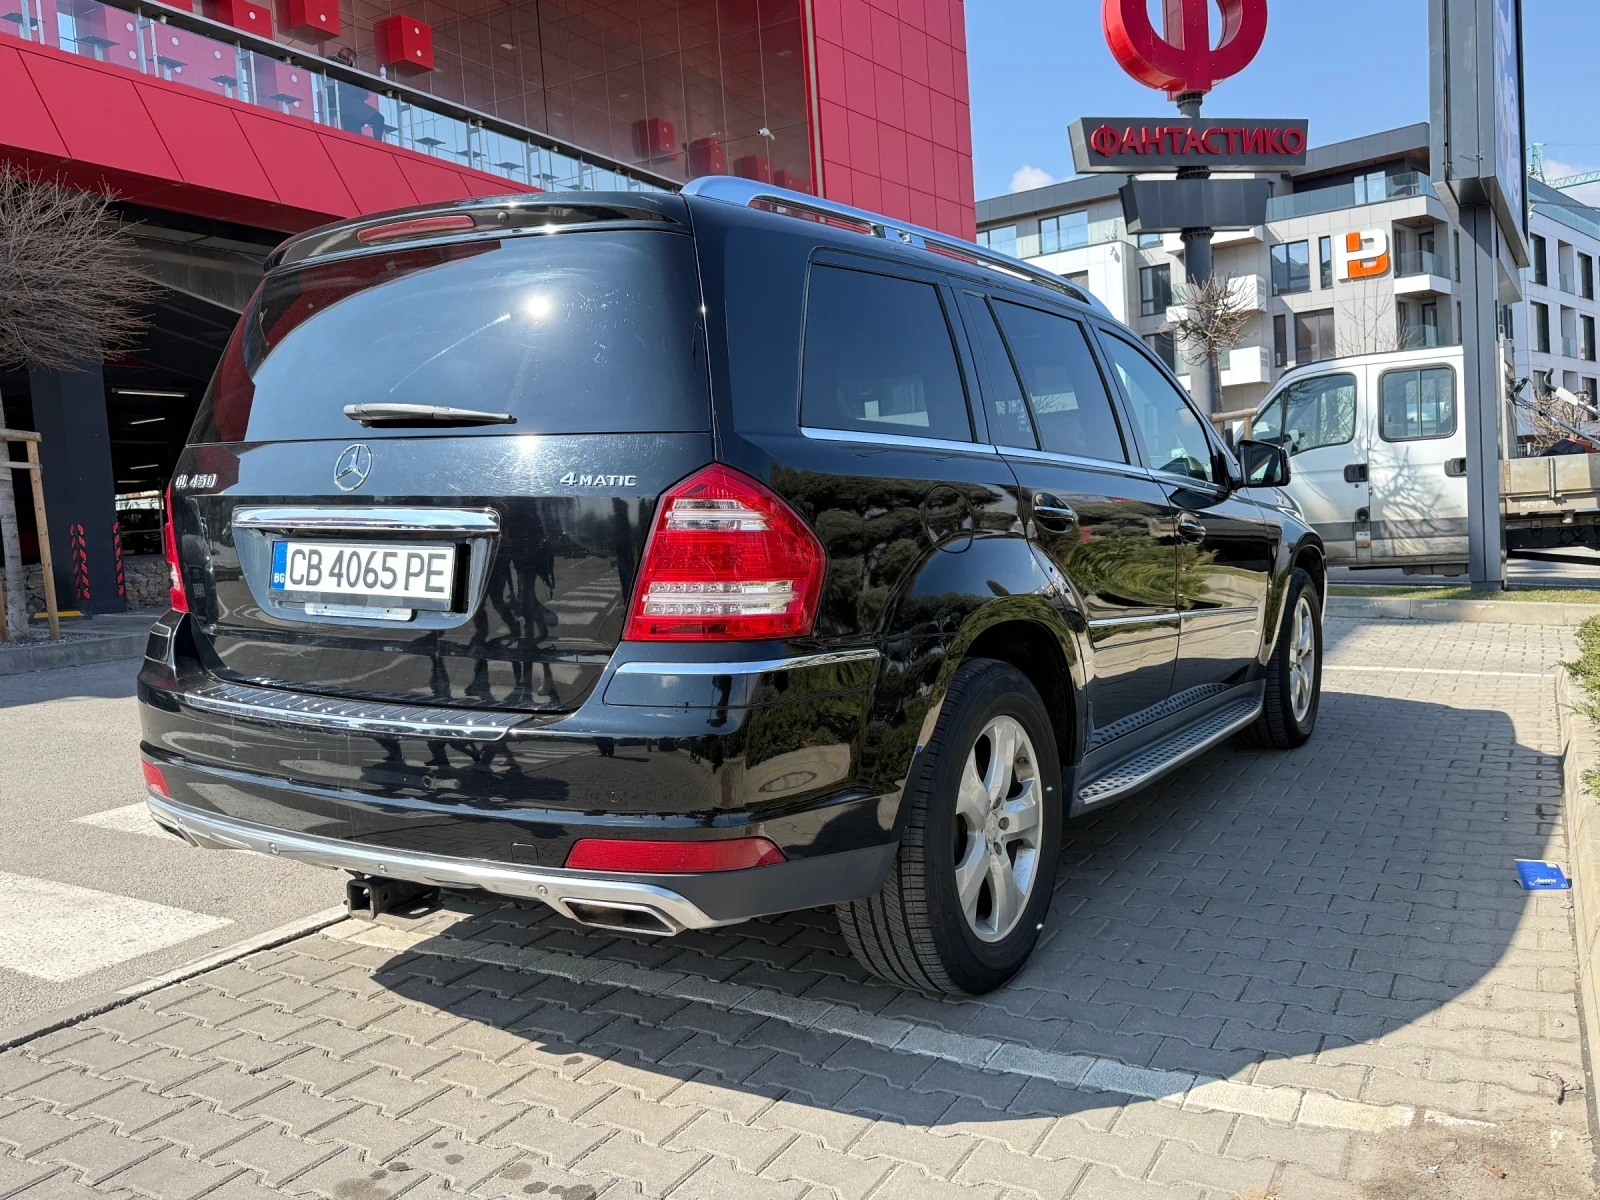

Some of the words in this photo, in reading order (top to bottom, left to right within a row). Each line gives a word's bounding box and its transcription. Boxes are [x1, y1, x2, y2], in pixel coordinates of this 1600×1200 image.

[1091, 125, 1305, 156] ФАНТАСТИКО
[189, 473, 218, 489] 450
[560, 471, 638, 487] 4MATIC
[273, 573, 285, 584] BG
[290, 549, 323, 586] CB
[328, 550, 397, 590] 4065
[404, 553, 447, 593] PE
